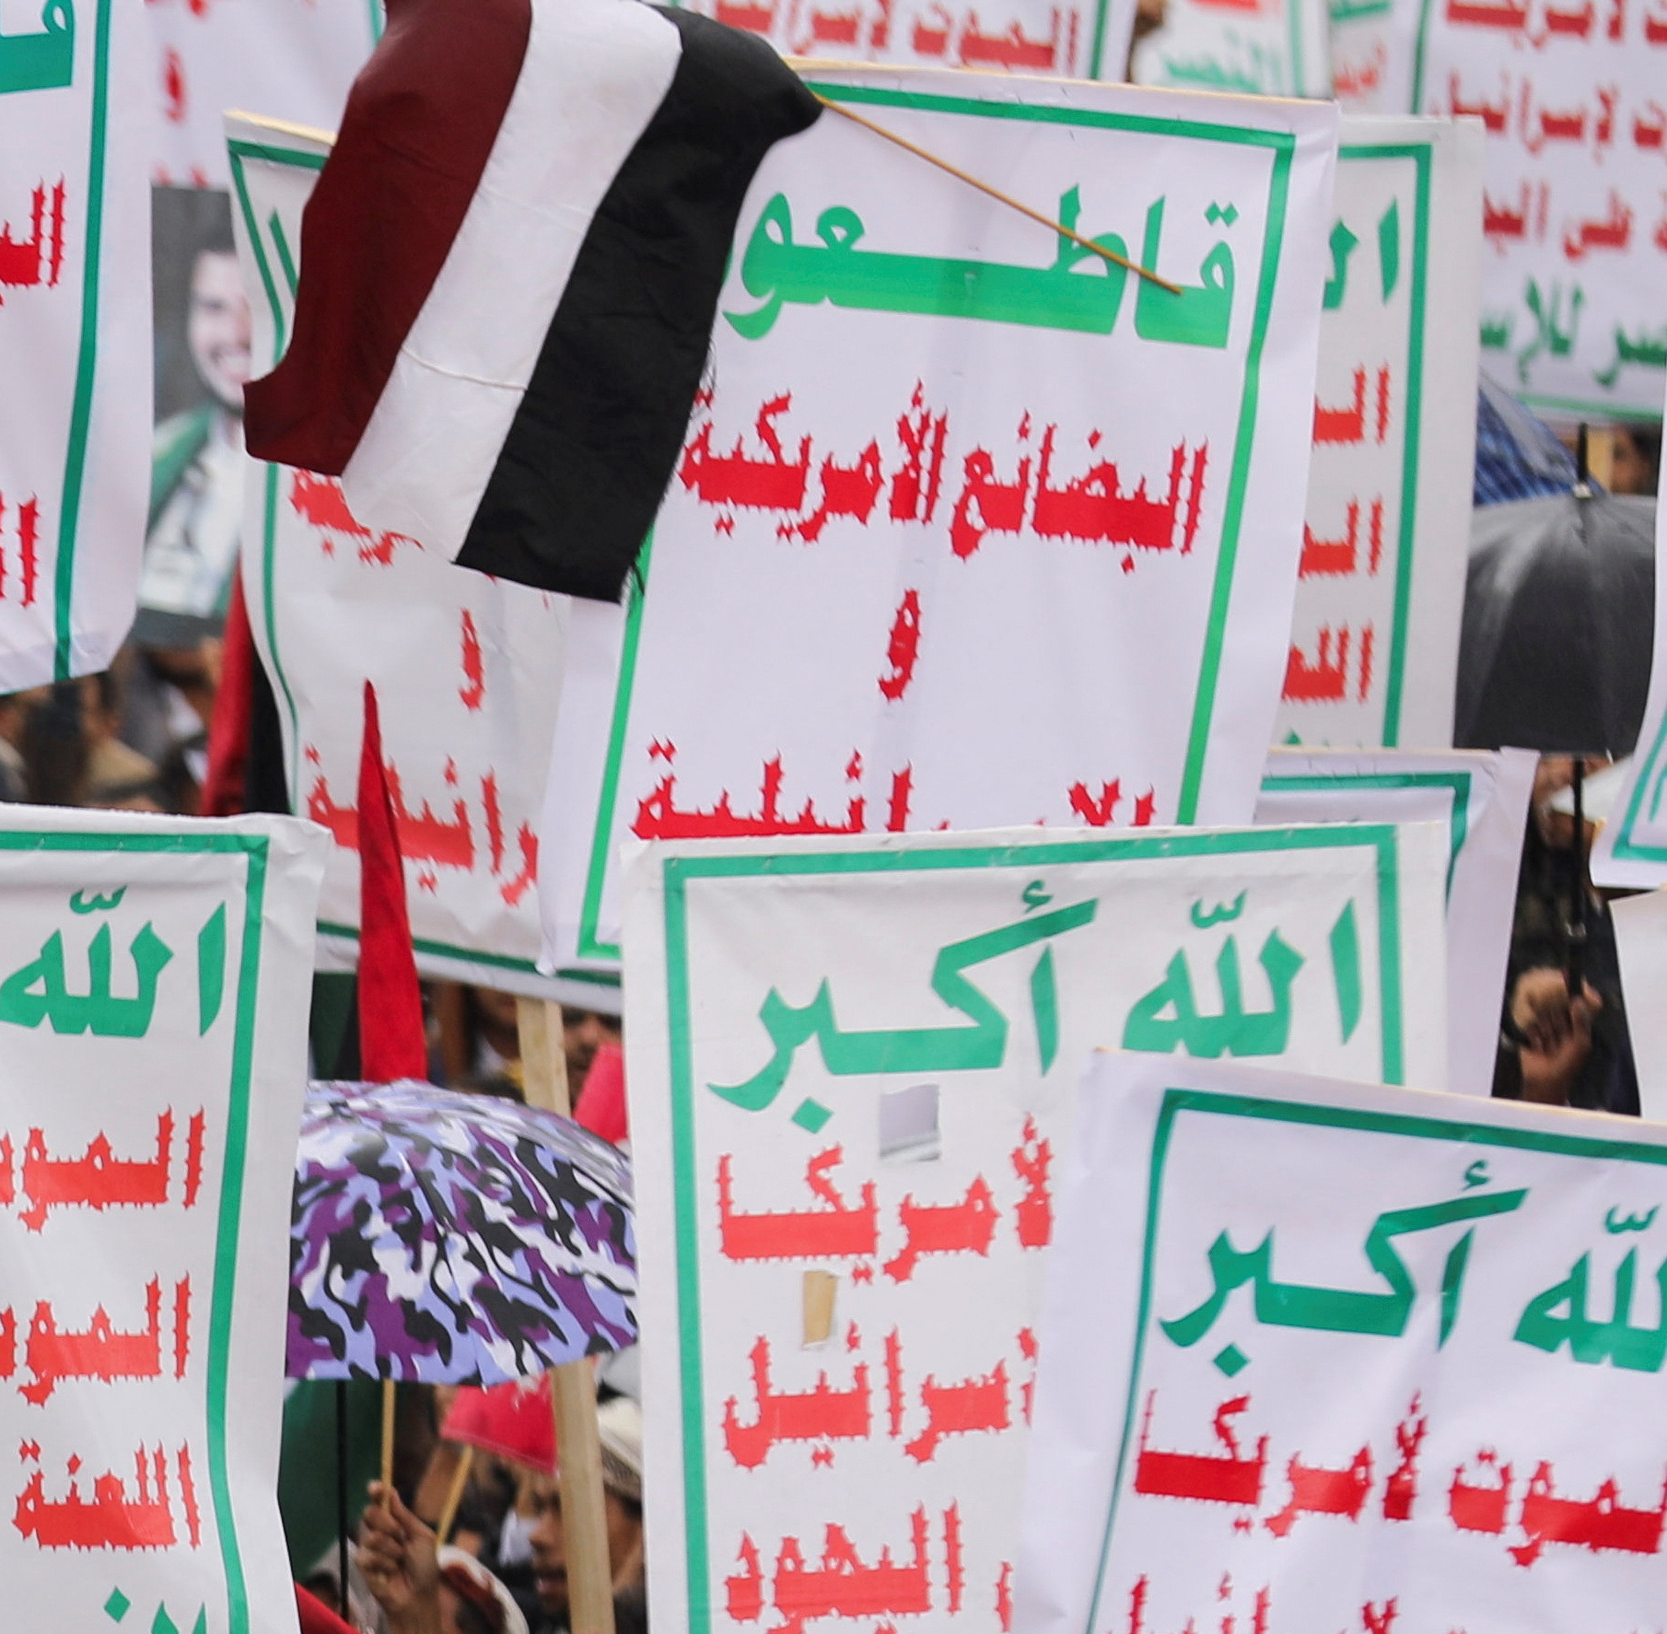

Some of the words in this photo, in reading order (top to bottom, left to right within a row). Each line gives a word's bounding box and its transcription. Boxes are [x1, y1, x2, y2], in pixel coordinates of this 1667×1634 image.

[723, 186, 1239, 349] قاطعو
[678, 383, 948, 543] الأمريكية
[949, 414, 1208, 572] البضائع
[459, 610, 485, 710] و
[879, 590, 921, 700] و
[709, 881, 1098, 1133] أكبر
[715, 1118, 1053, 1283] لأمريكا
[1162, 1161, 1528, 1375] أكبر
[13, 1442, 201, 1550] اللعنة
[1133, 1396, 1426, 1537] لأمريكا
